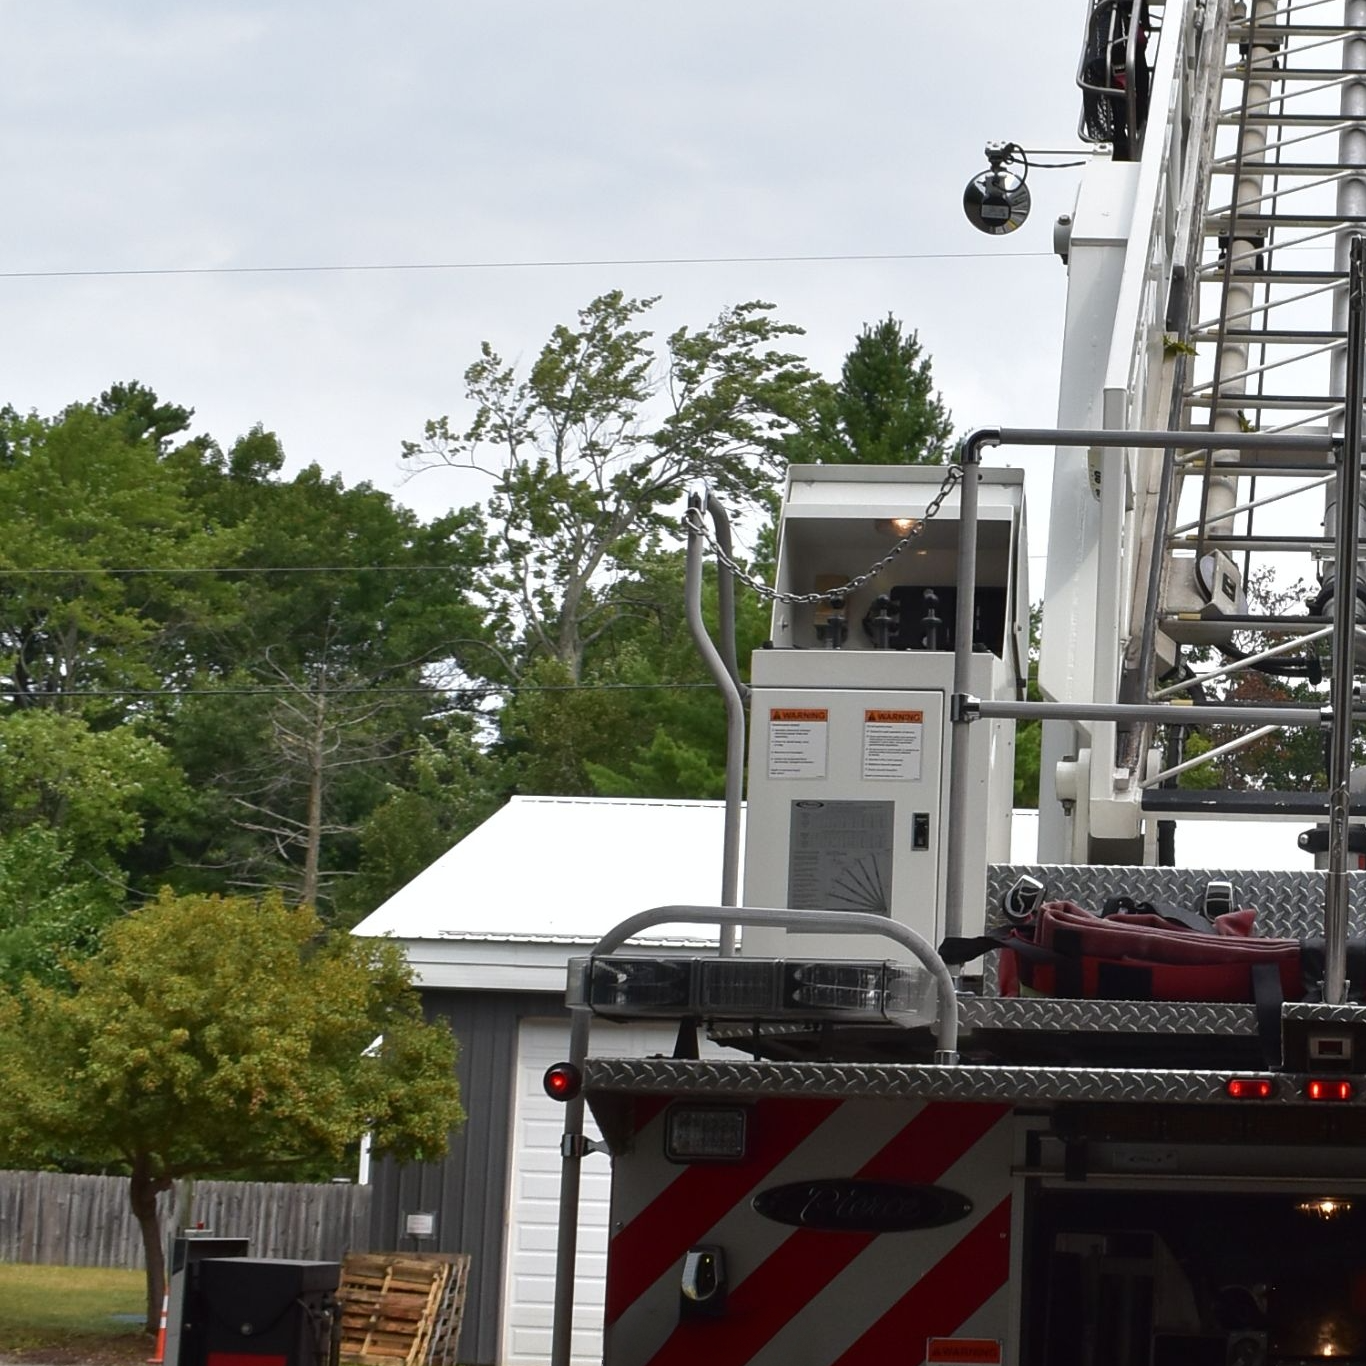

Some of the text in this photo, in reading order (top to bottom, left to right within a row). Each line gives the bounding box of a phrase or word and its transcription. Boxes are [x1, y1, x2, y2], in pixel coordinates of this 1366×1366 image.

[783, 711, 826, 720] WARNING
[878, 712, 921, 721] WARNING
[800, 1186, 921, 1222] Pierce
